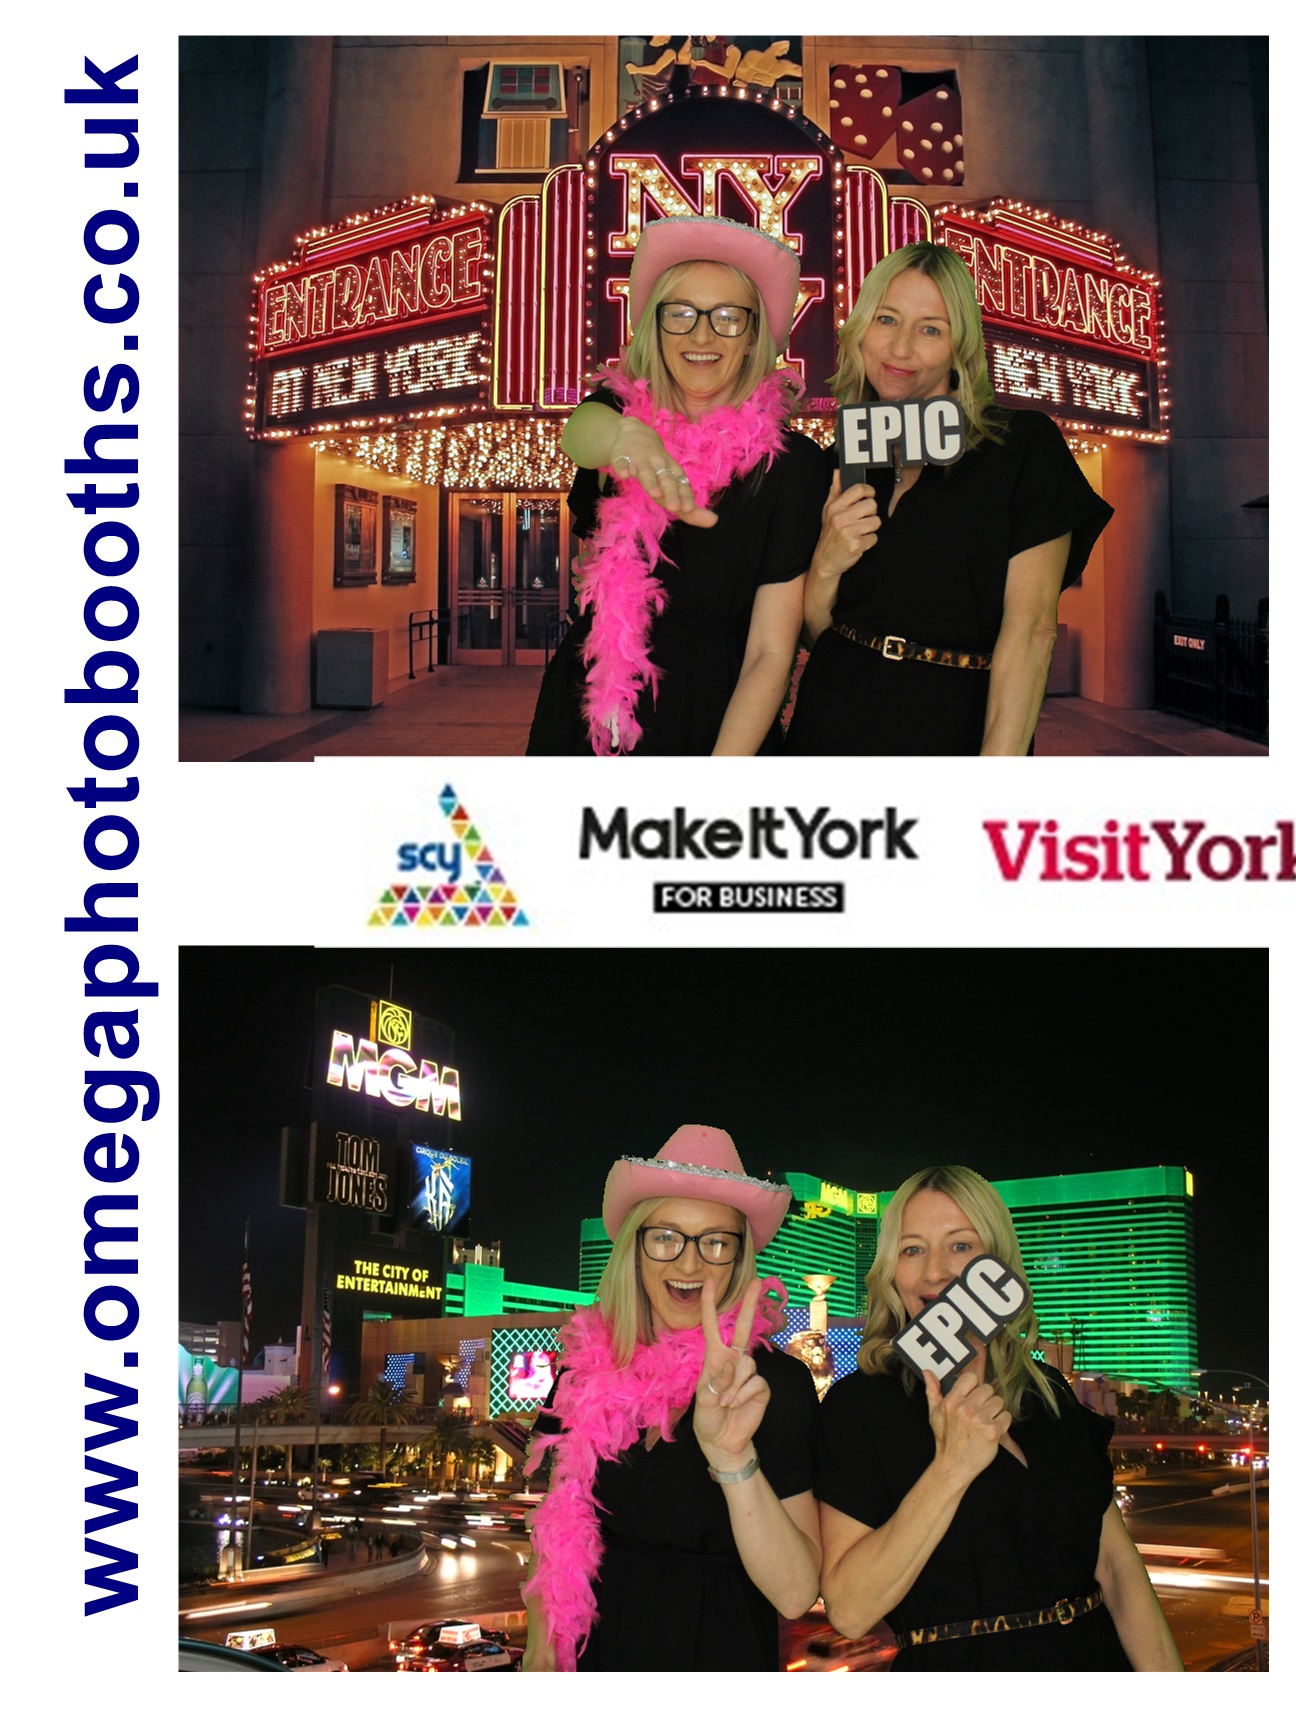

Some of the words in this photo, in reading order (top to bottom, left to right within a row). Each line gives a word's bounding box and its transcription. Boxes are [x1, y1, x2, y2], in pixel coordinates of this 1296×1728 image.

[609, 153, 823, 255] NY
[264, 227, 482, 346] ENTRANCE
[311, 353, 378, 409] NEW
[384, 331, 482, 398] YORK
[993, 343, 1061, 405] NEW
[1066, 358, 1142, 417] YORK
[843, 400, 961, 465] EPIC
[1173, 635, 1187, 647] EXIT
[1188, 638, 1205, 650] ONLY
[326, 1029, 462, 1122] MGM
[335, 1131, 380, 1172] TOM
[415, 1146, 439, 1160] CIRQUE
[449, 1154, 469, 1166] SOLEIL
[326, 1168, 388, 1213] JONES
[336, 1274, 443, 1300] ENTERTAINMENT
[354, 1260, 380, 1276] THE
[382, 1264, 410, 1280] CITY
[411, 1268, 429, 1283] OF
[899, 1263, 1025, 1381] EPIC
